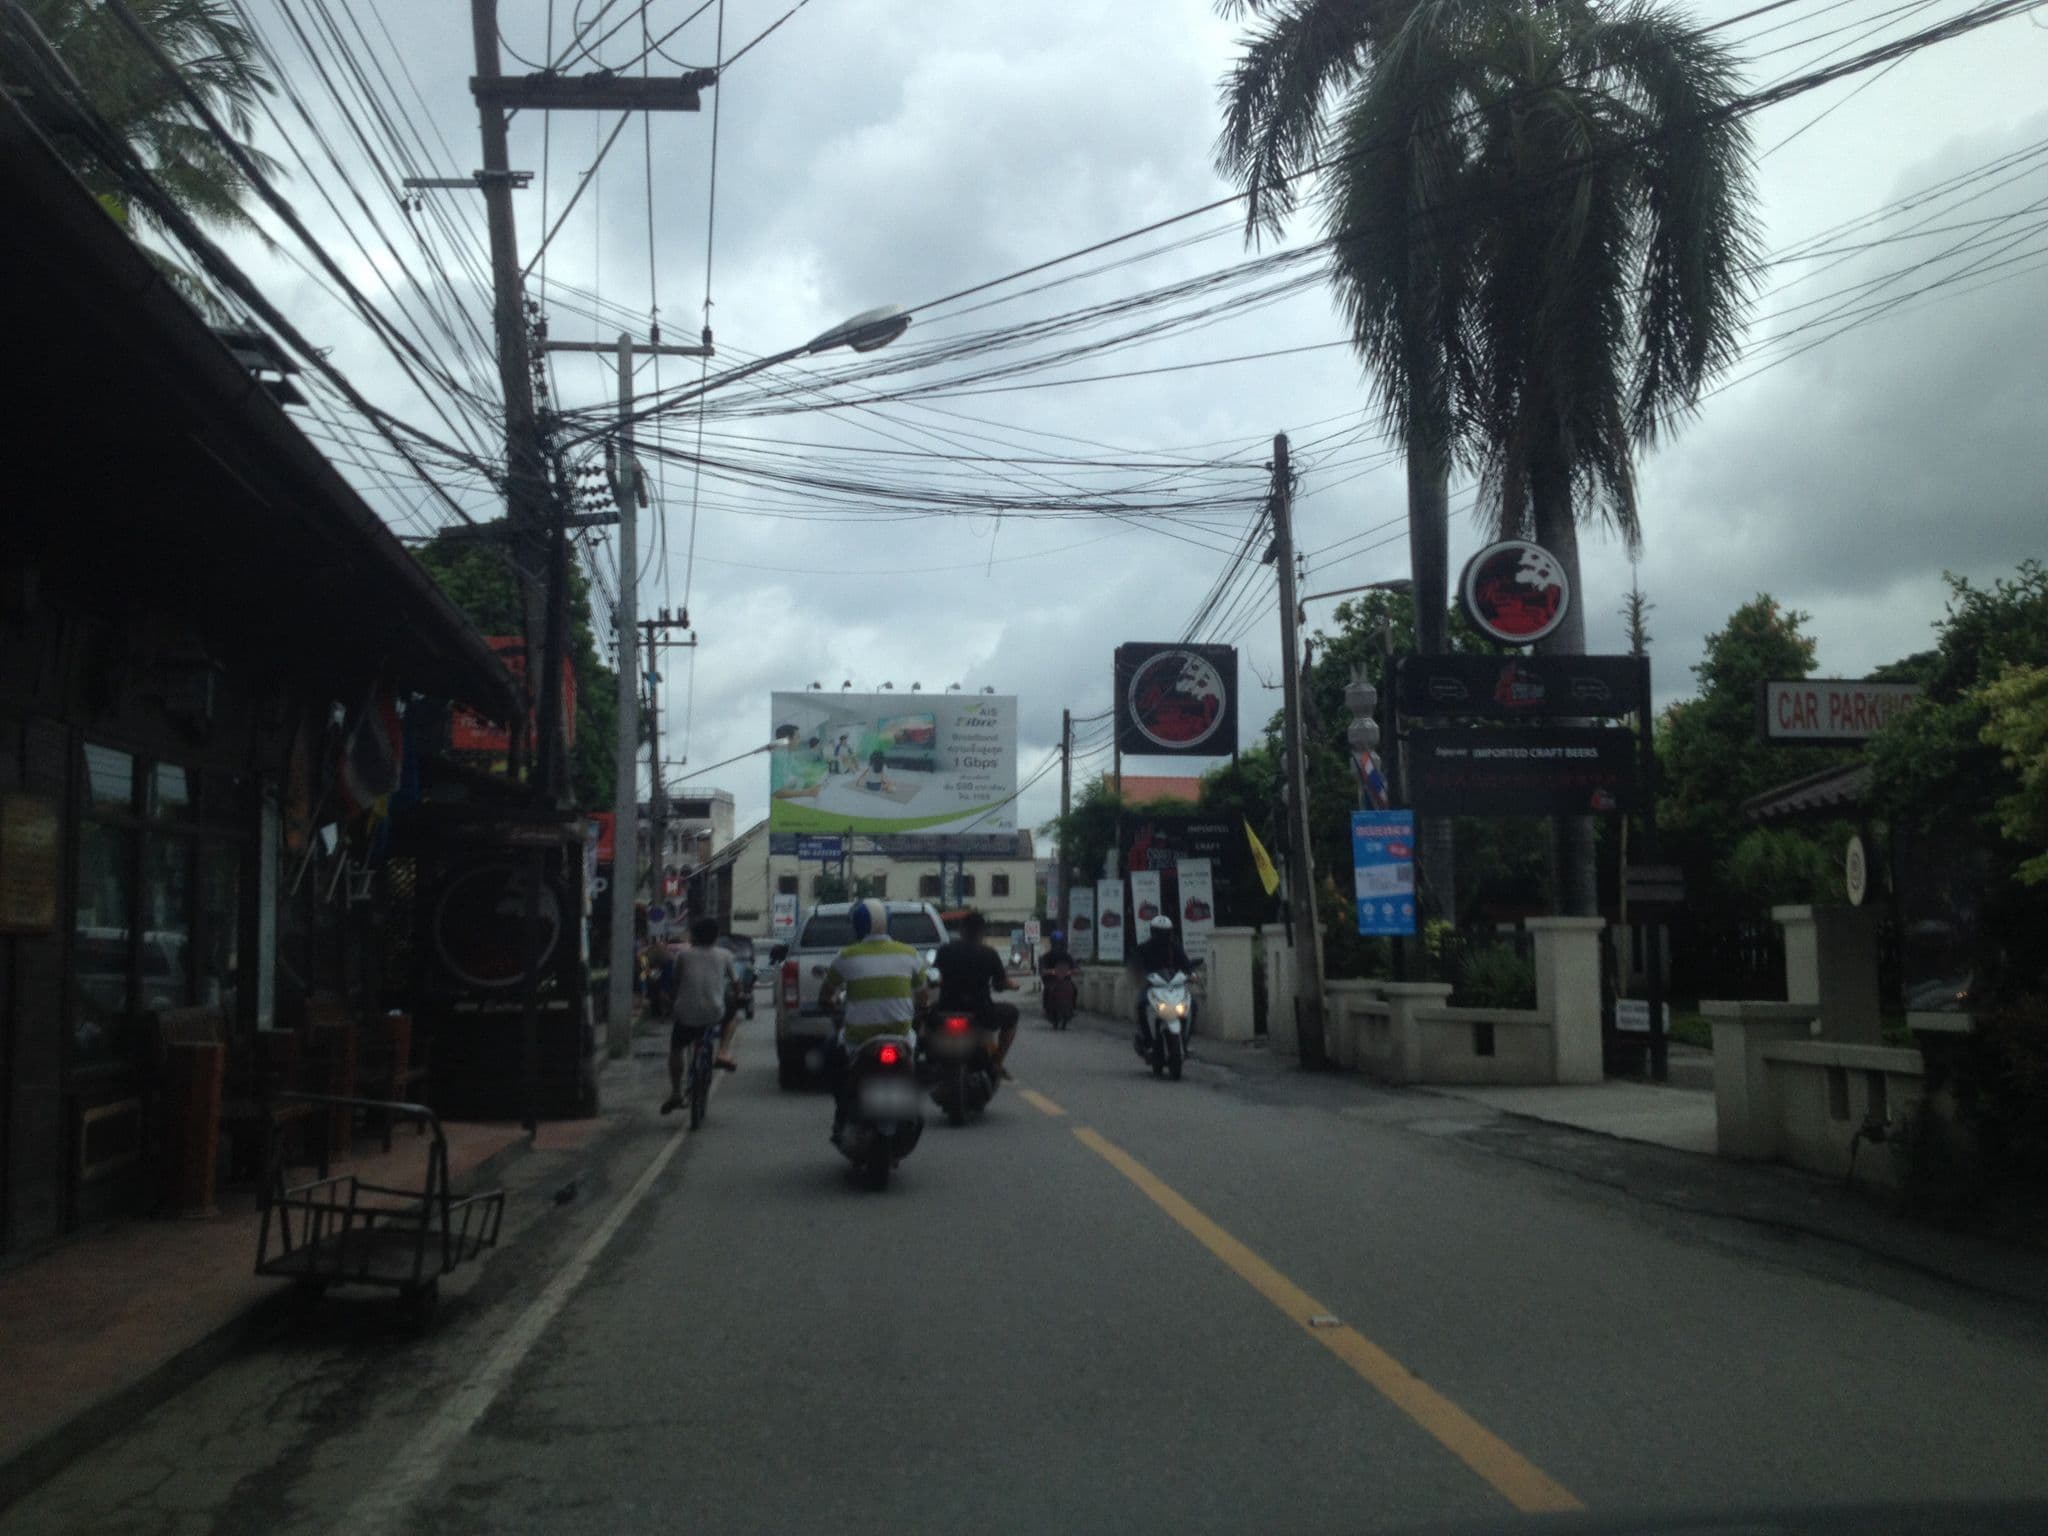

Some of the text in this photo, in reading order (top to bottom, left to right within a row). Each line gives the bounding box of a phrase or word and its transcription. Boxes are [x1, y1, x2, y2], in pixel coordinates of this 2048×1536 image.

[979, 707, 998, 716] AIS
[1778, 691, 1819, 729] CAR
[963, 756, 998, 770] Gbps
